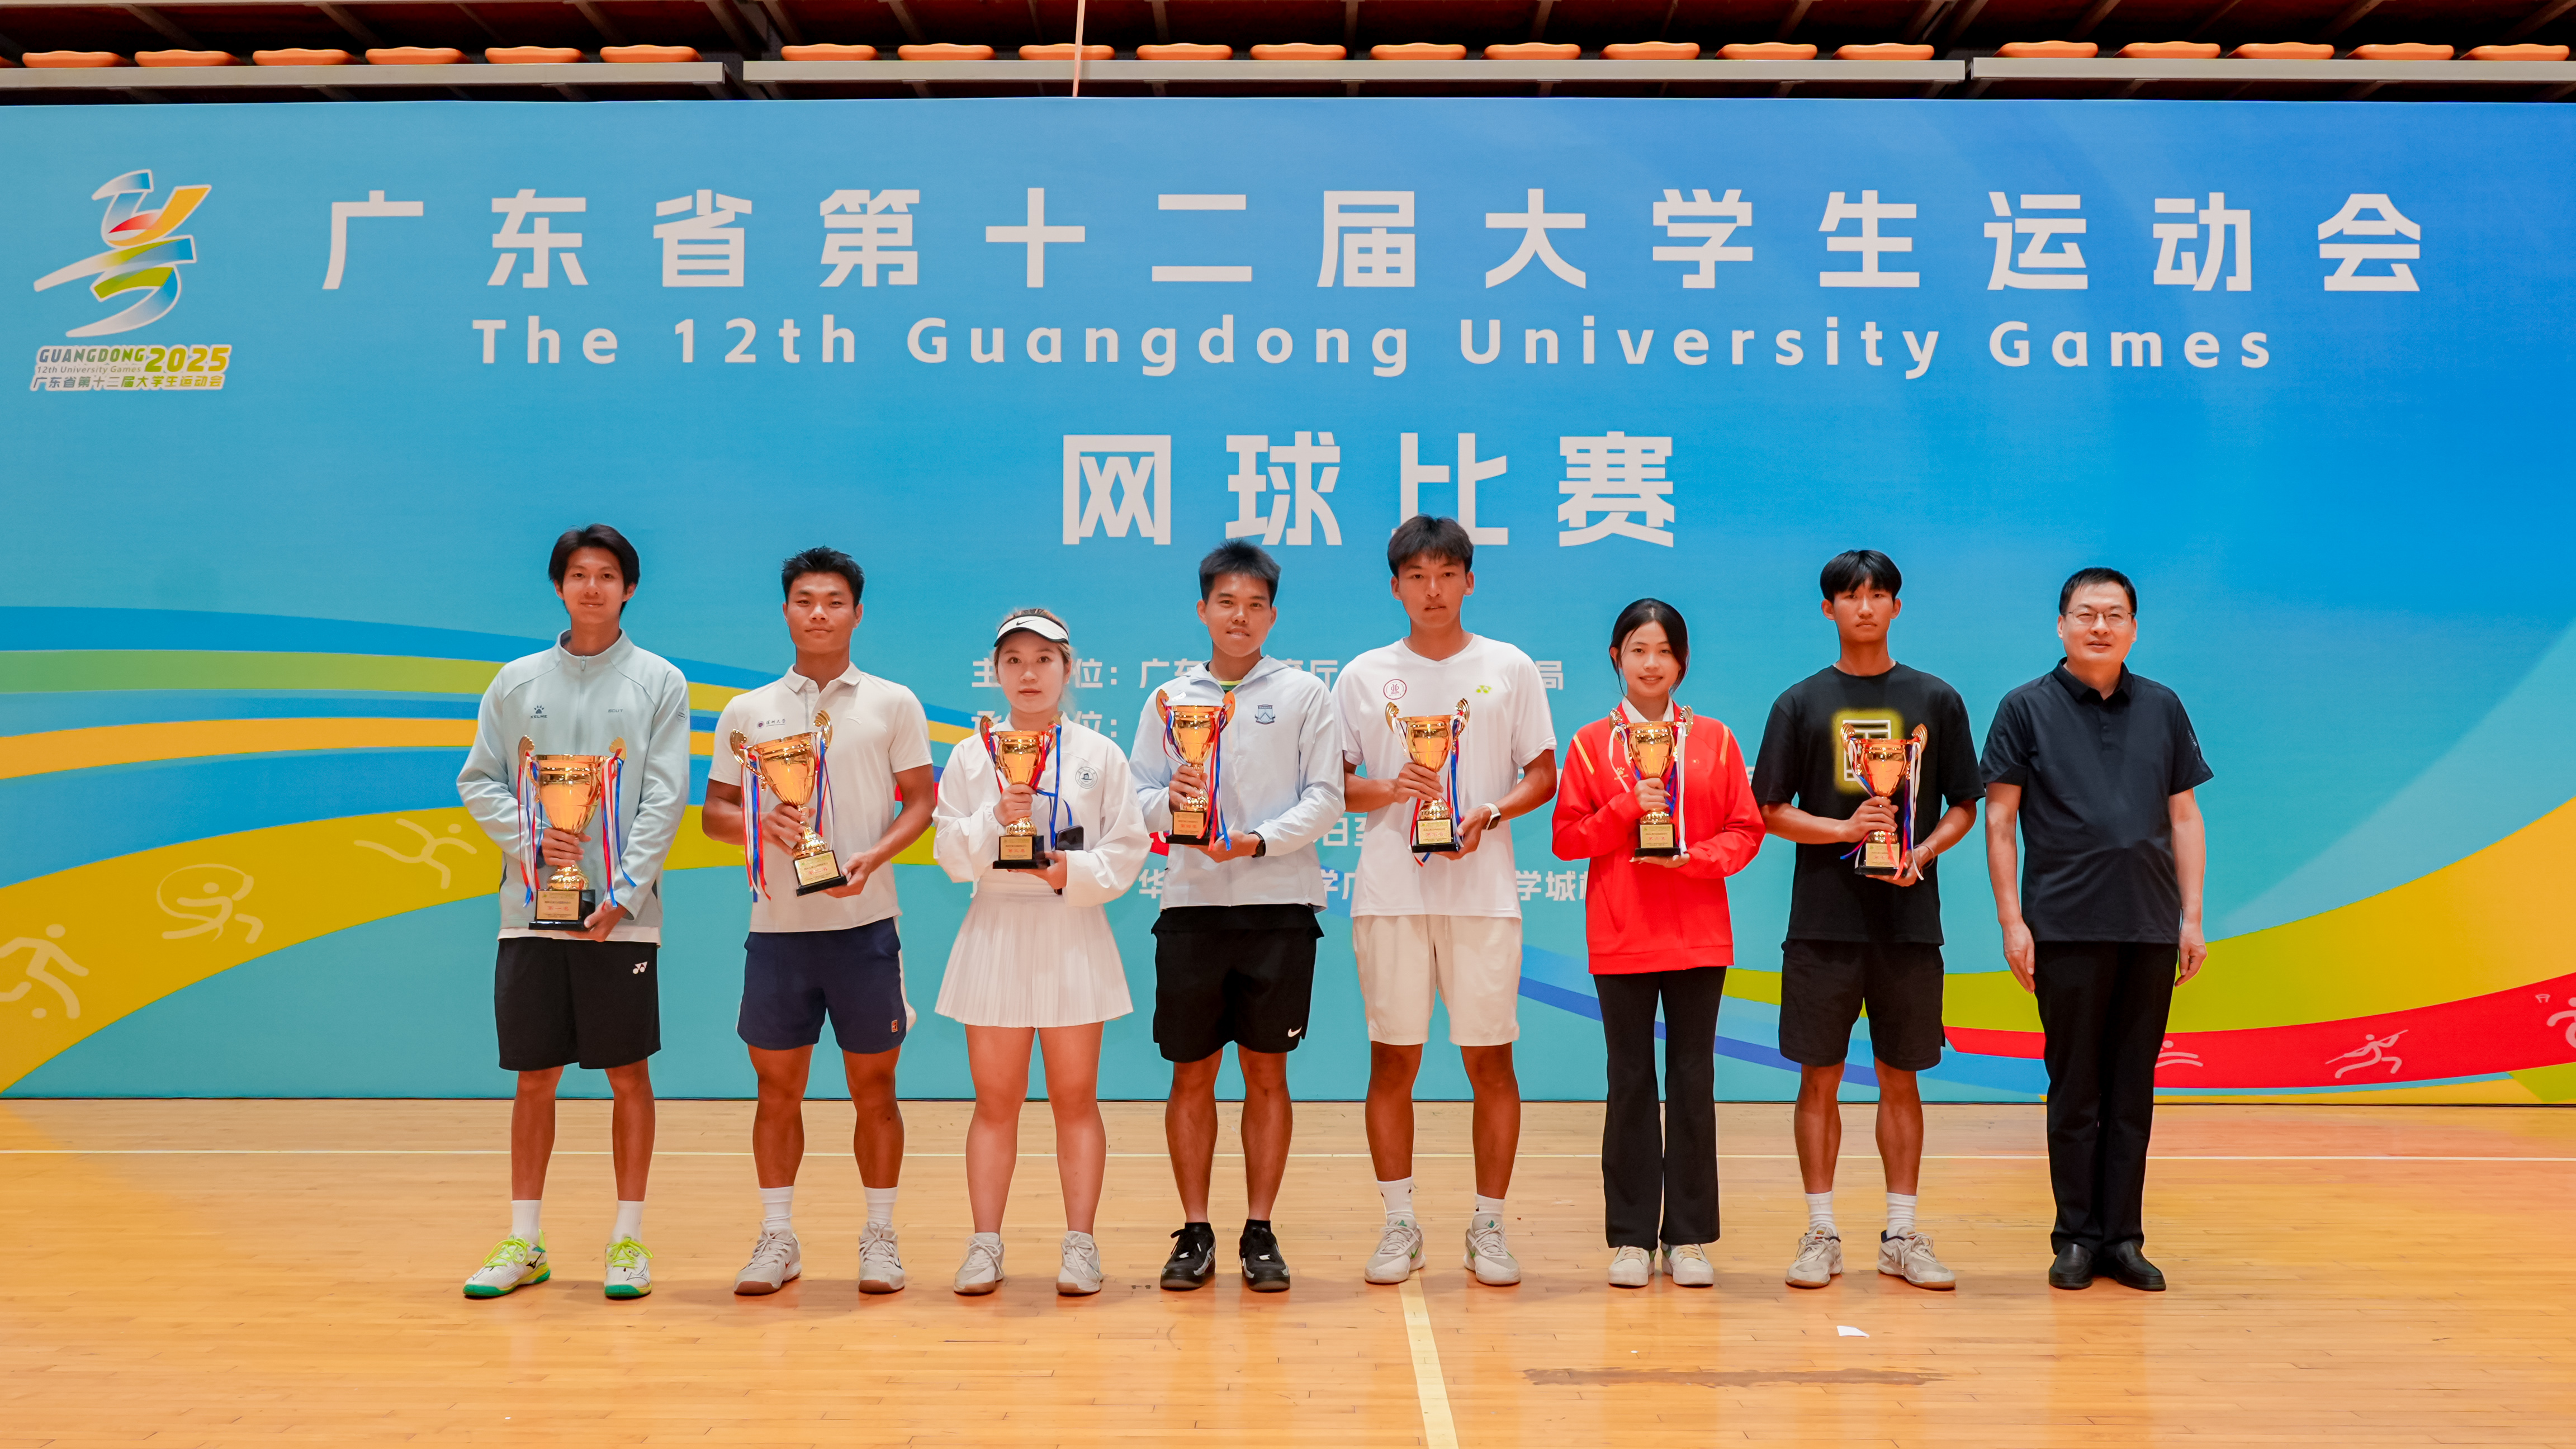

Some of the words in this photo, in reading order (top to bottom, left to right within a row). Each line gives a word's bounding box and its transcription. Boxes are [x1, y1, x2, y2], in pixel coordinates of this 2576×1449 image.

[323, 188, 2421, 291] 广东省第十二届大学生运动会
[39, 348, 145, 363] GUANGDONG
[144, 347, 229, 372] 2025
[472, 315, 617, 364] The
[675, 314, 855, 363] 12th
[907, 314, 1407, 378] Guangdong
[1461, 315, 1939, 380] University
[1989, 321, 2270, 368] Games
[33, 376, 223, 388] 广东省第十二届大学生运动会
[1063, 431, 1675, 547] 网球比赛
